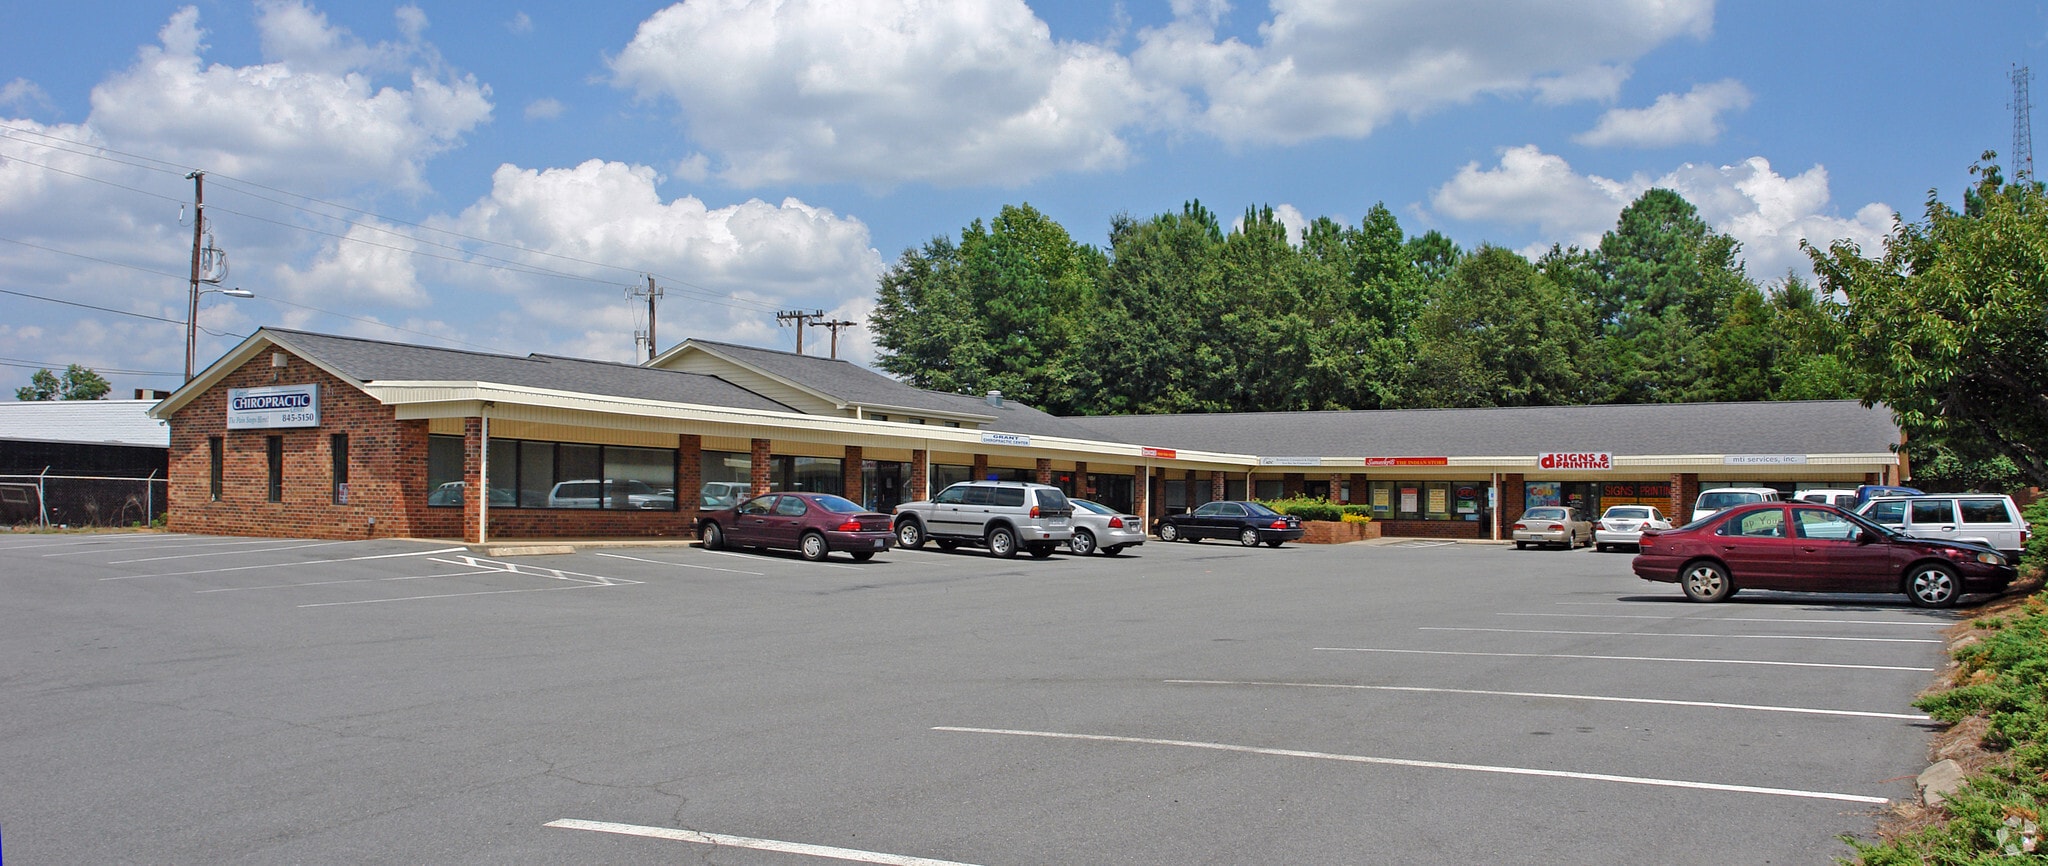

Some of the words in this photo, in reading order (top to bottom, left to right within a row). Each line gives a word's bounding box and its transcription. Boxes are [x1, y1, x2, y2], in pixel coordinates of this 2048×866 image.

[233, 394, 309, 410] CHIROPRACTIC
[282, 413, 314, 422] 845-5150
[1556, 453, 1595, 461] SIGNS
[1600, 453, 1609, 462] &
[1555, 461, 1610, 469] PRINTING
[1456, 489, 1478, 497] OPEN
[1605, 485, 1634, 496] SIGNS
[1639, 485, 1672, 496] PRINTIN
